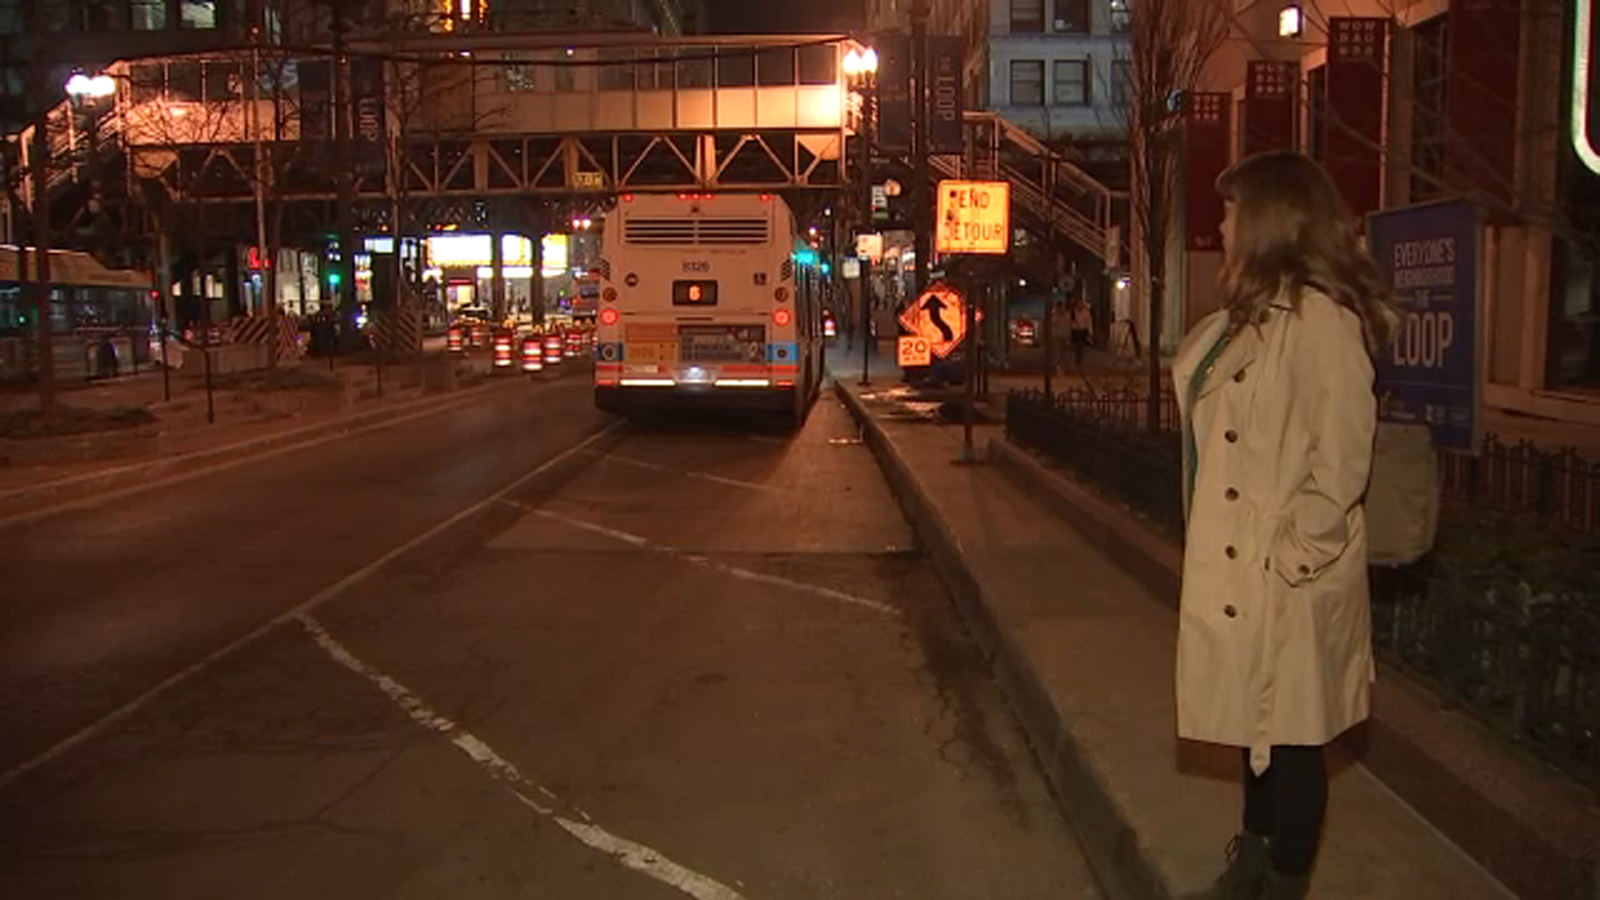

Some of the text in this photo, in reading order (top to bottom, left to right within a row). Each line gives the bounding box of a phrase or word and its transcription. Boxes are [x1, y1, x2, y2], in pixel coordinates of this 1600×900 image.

[936, 76, 956, 121] LOOP
[959, 187, 991, 210] END
[944, 222, 1004, 241] DETOUR
[1394, 237, 1456, 268] EVERYONE'S
[689, 285, 701, 301] 6
[902, 340, 928, 356] 20
[1394, 311, 1455, 369] LOOP
